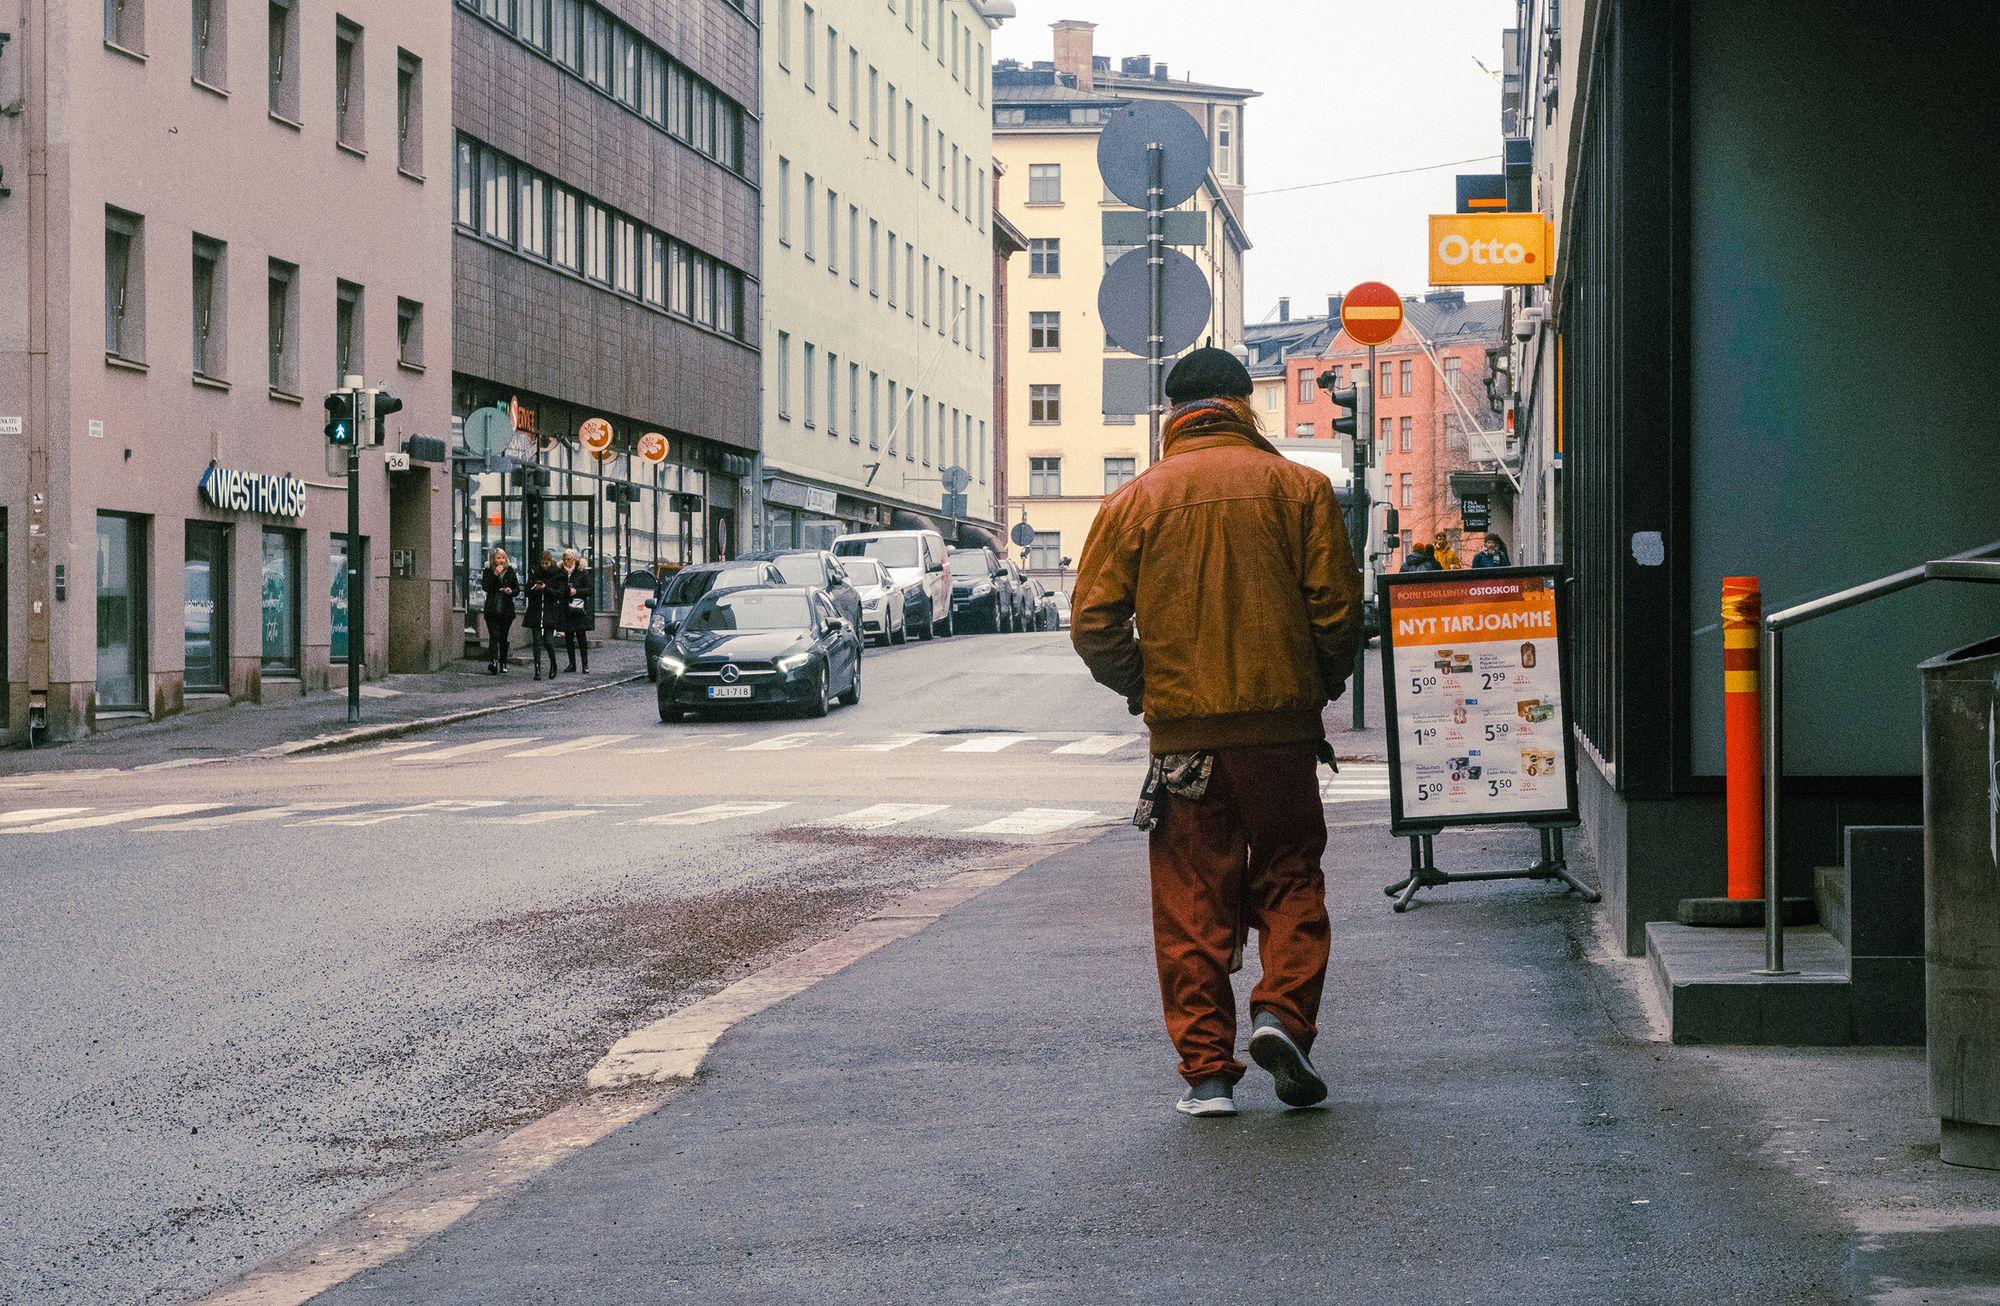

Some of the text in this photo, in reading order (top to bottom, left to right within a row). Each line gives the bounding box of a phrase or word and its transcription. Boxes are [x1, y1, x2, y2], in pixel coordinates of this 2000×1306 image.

[391, 458, 404, 467] 36
[1469, 585, 1519, 597] OSTOSKORI
[1399, 612, 1552, 636] NYT TARJOAMME
[715, 687, 749, 696] JLI-718
